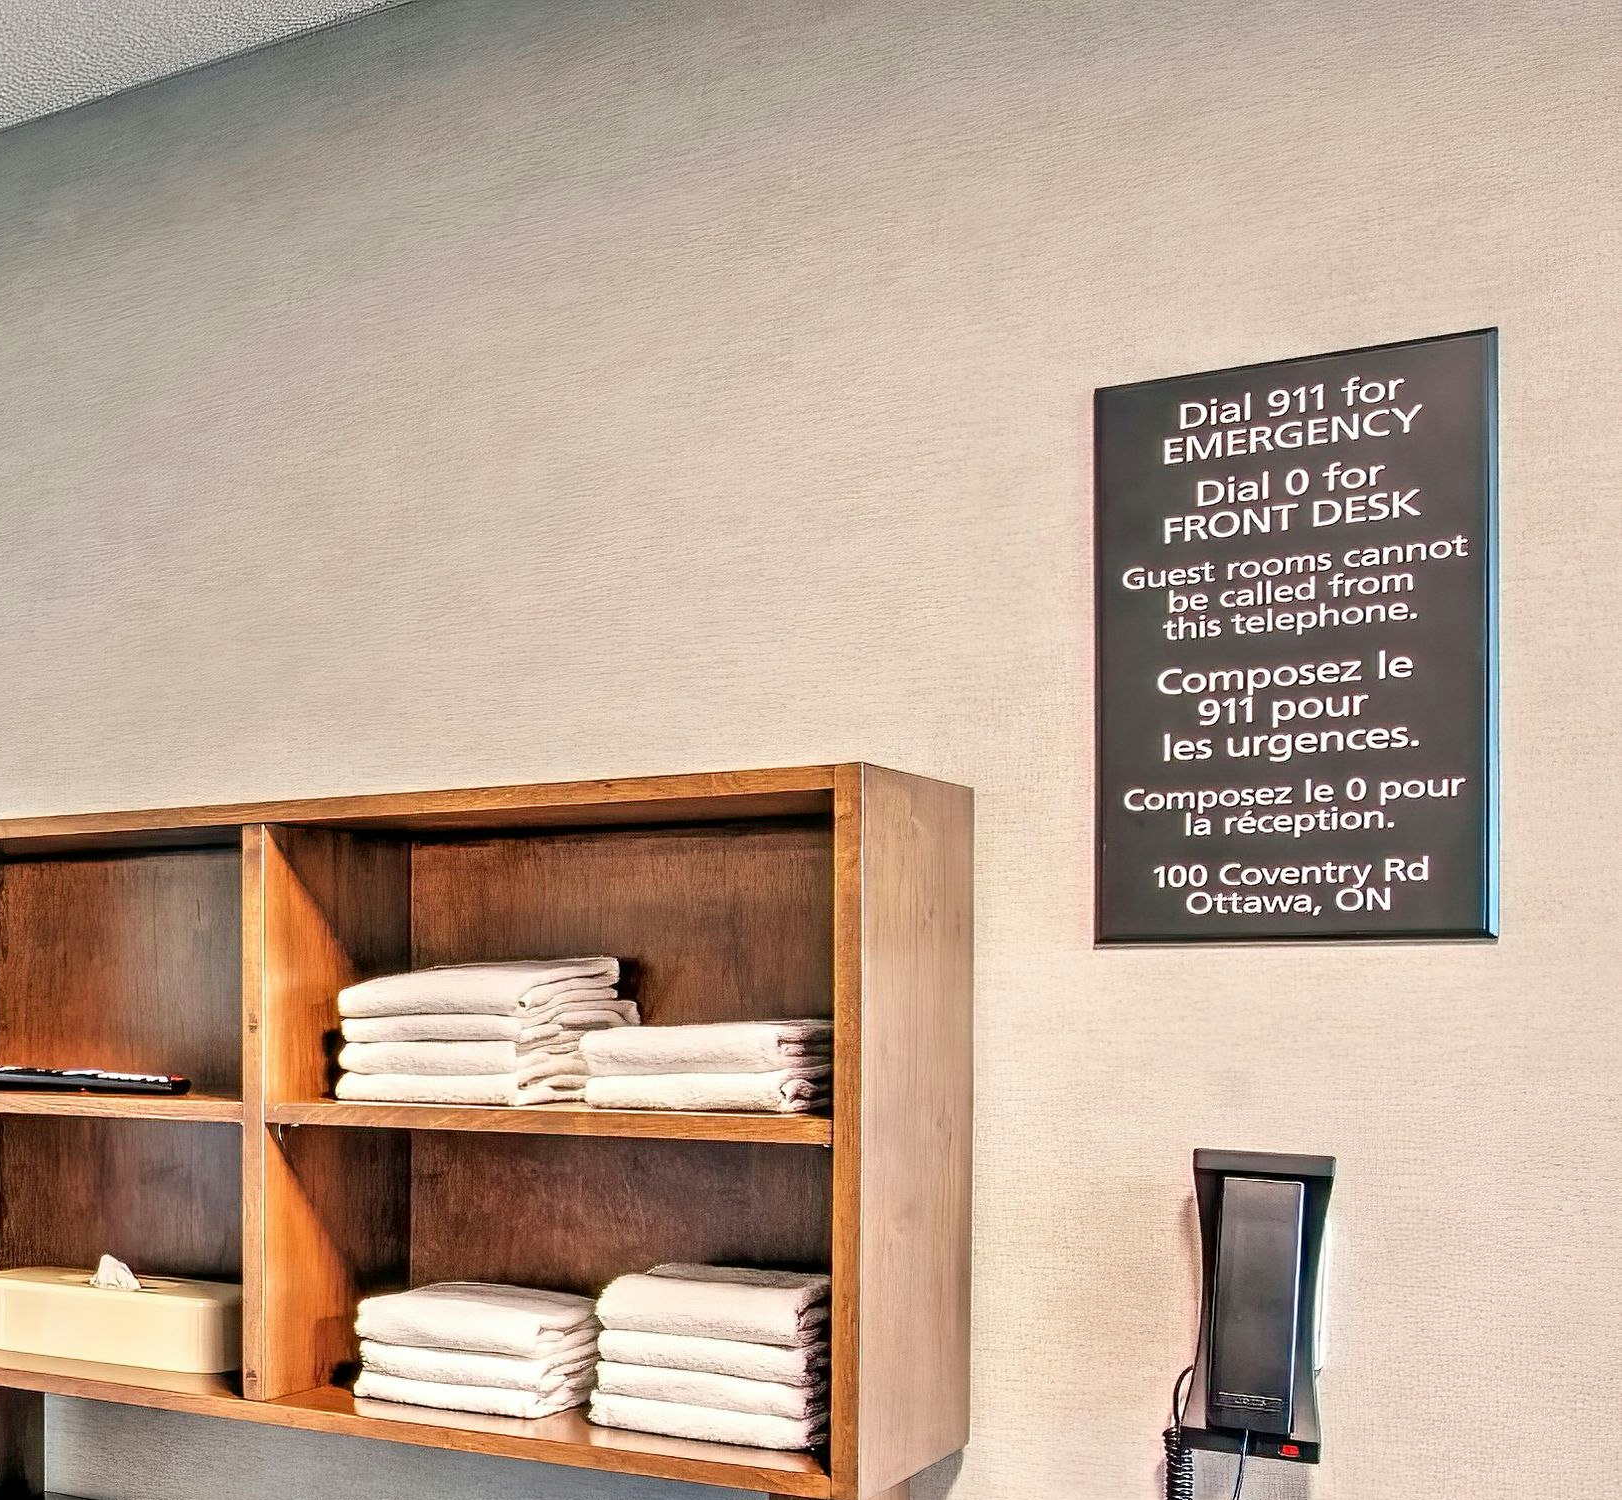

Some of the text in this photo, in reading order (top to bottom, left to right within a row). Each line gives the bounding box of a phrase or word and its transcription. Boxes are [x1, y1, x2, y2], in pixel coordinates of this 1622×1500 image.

[1180, 376, 1404, 429] Dial 911 for
[1164, 404, 1422, 464] EMERGENCY
[1197, 461, 1385, 506] Dial 0 for
[1164, 489, 1421, 544] FRONT DESK
[1122, 535, 1468, 589] Guest rooms cannot
[1169, 572, 1413, 613] be called from
[1163, 601, 1417, 640] this telephone.
[1157, 649, 1413, 695] Composez le
[1198, 695, 1369, 728] 911 pour
[1164, 727, 1419, 762] les urgences.
[1124, 776, 1466, 814] Composez le 0 pour
[1186, 806, 1394, 837] la réception.
[1154, 855, 1429, 888] 100 Coventry Rd
[1186, 886, 1390, 915] Ottawa, ON
